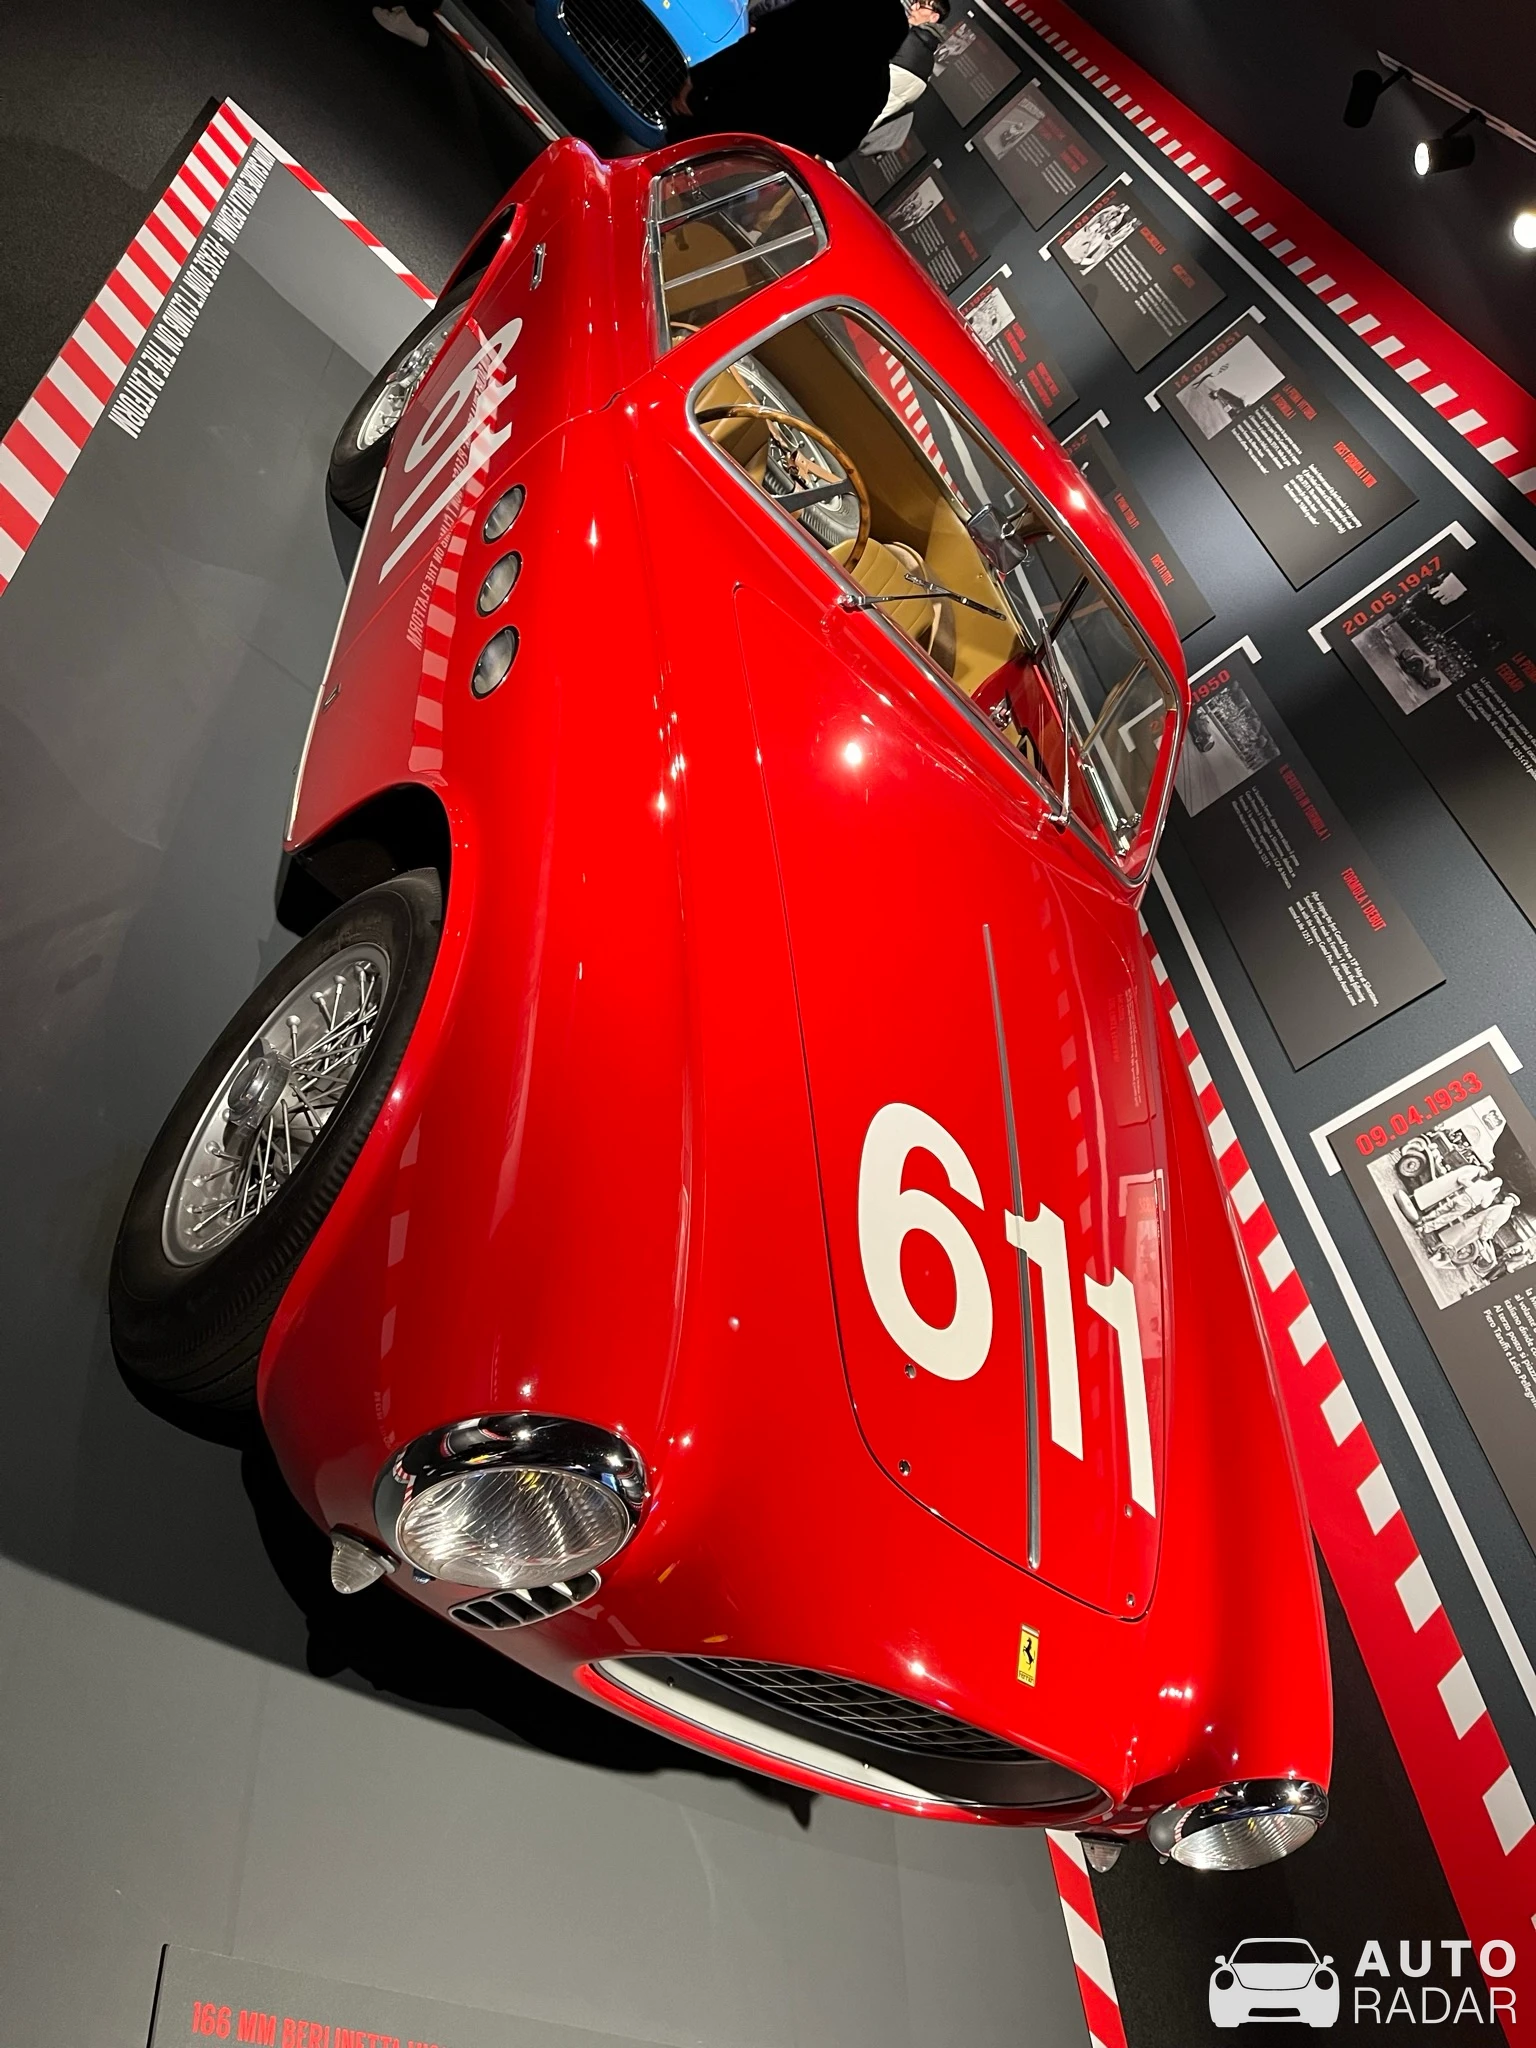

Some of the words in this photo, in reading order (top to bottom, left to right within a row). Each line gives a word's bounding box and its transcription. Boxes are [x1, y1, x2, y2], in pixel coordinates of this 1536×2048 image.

[239, 156, 269, 194] SALIRE
[227, 178, 258, 215] SULLA
[211, 199, 247, 244] PEDANA
[192, 233, 230, 281] PLEASE
[178, 263, 214, 309] DON'T
[162, 292, 199, 338] CLIMB
[140, 339, 177, 378] THE
[152, 323, 184, 356] ON
[1174, 331, 1242, 388] 14.07.1951
[107, 360, 165, 438] PLATFORM
[1342, 554, 1444, 638] 20.05.1947
[1512, 747, 1523, 757] 125
[1303, 804, 1328, 838] FORMULA
[1341, 867, 1369, 904] FORMULA
[1362, 904, 1387, 932] DEBUT
[1301, 929, 1311, 939] 125
[1354, 1070, 1484, 1156] 09.04.1933
[857, 1102, 1157, 1519] 611
[1493, 1304, 1504, 1314] Al
[1514, 1293, 1525, 1302] al
[1519, 1301, 1536, 1327] volante
[1483, 1309, 1496, 1328] Piero
[1494, 1327, 1511, 1352] Taruffi
[1508, 1356, 1521, 1375] Lelio
[1498, 1312, 1511, 1331] terzo
[1504, 1298, 1521, 1326] italiano
[1519, 1325, 1534, 1347] divide
[1506, 1331, 1522, 1352] posto
[1520, 1351, 1529, 1359] si
[192, 2001, 232, 2039] 166
[236, 2010, 277, 2047] MM
